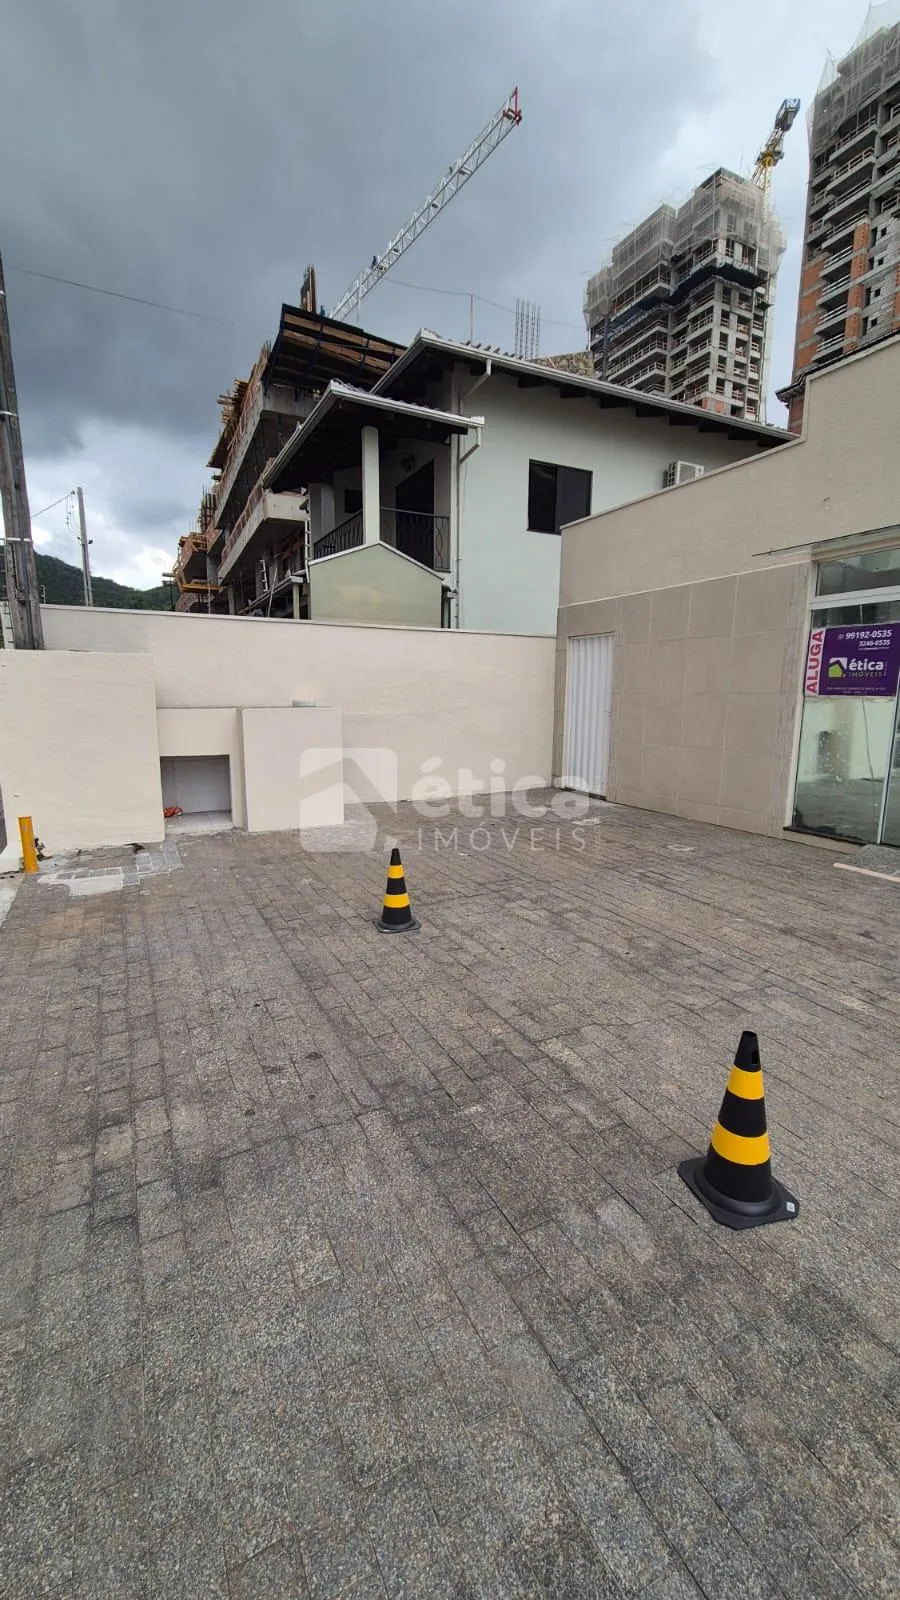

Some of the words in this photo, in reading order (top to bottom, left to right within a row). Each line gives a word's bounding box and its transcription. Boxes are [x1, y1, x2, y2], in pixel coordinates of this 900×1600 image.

[845, 630, 892, 640] 99192-0535
[806, 630, 824, 694] ALUGA
[849, 658, 884, 671] ética
[848, 670, 883, 678] IMÓVEIS
